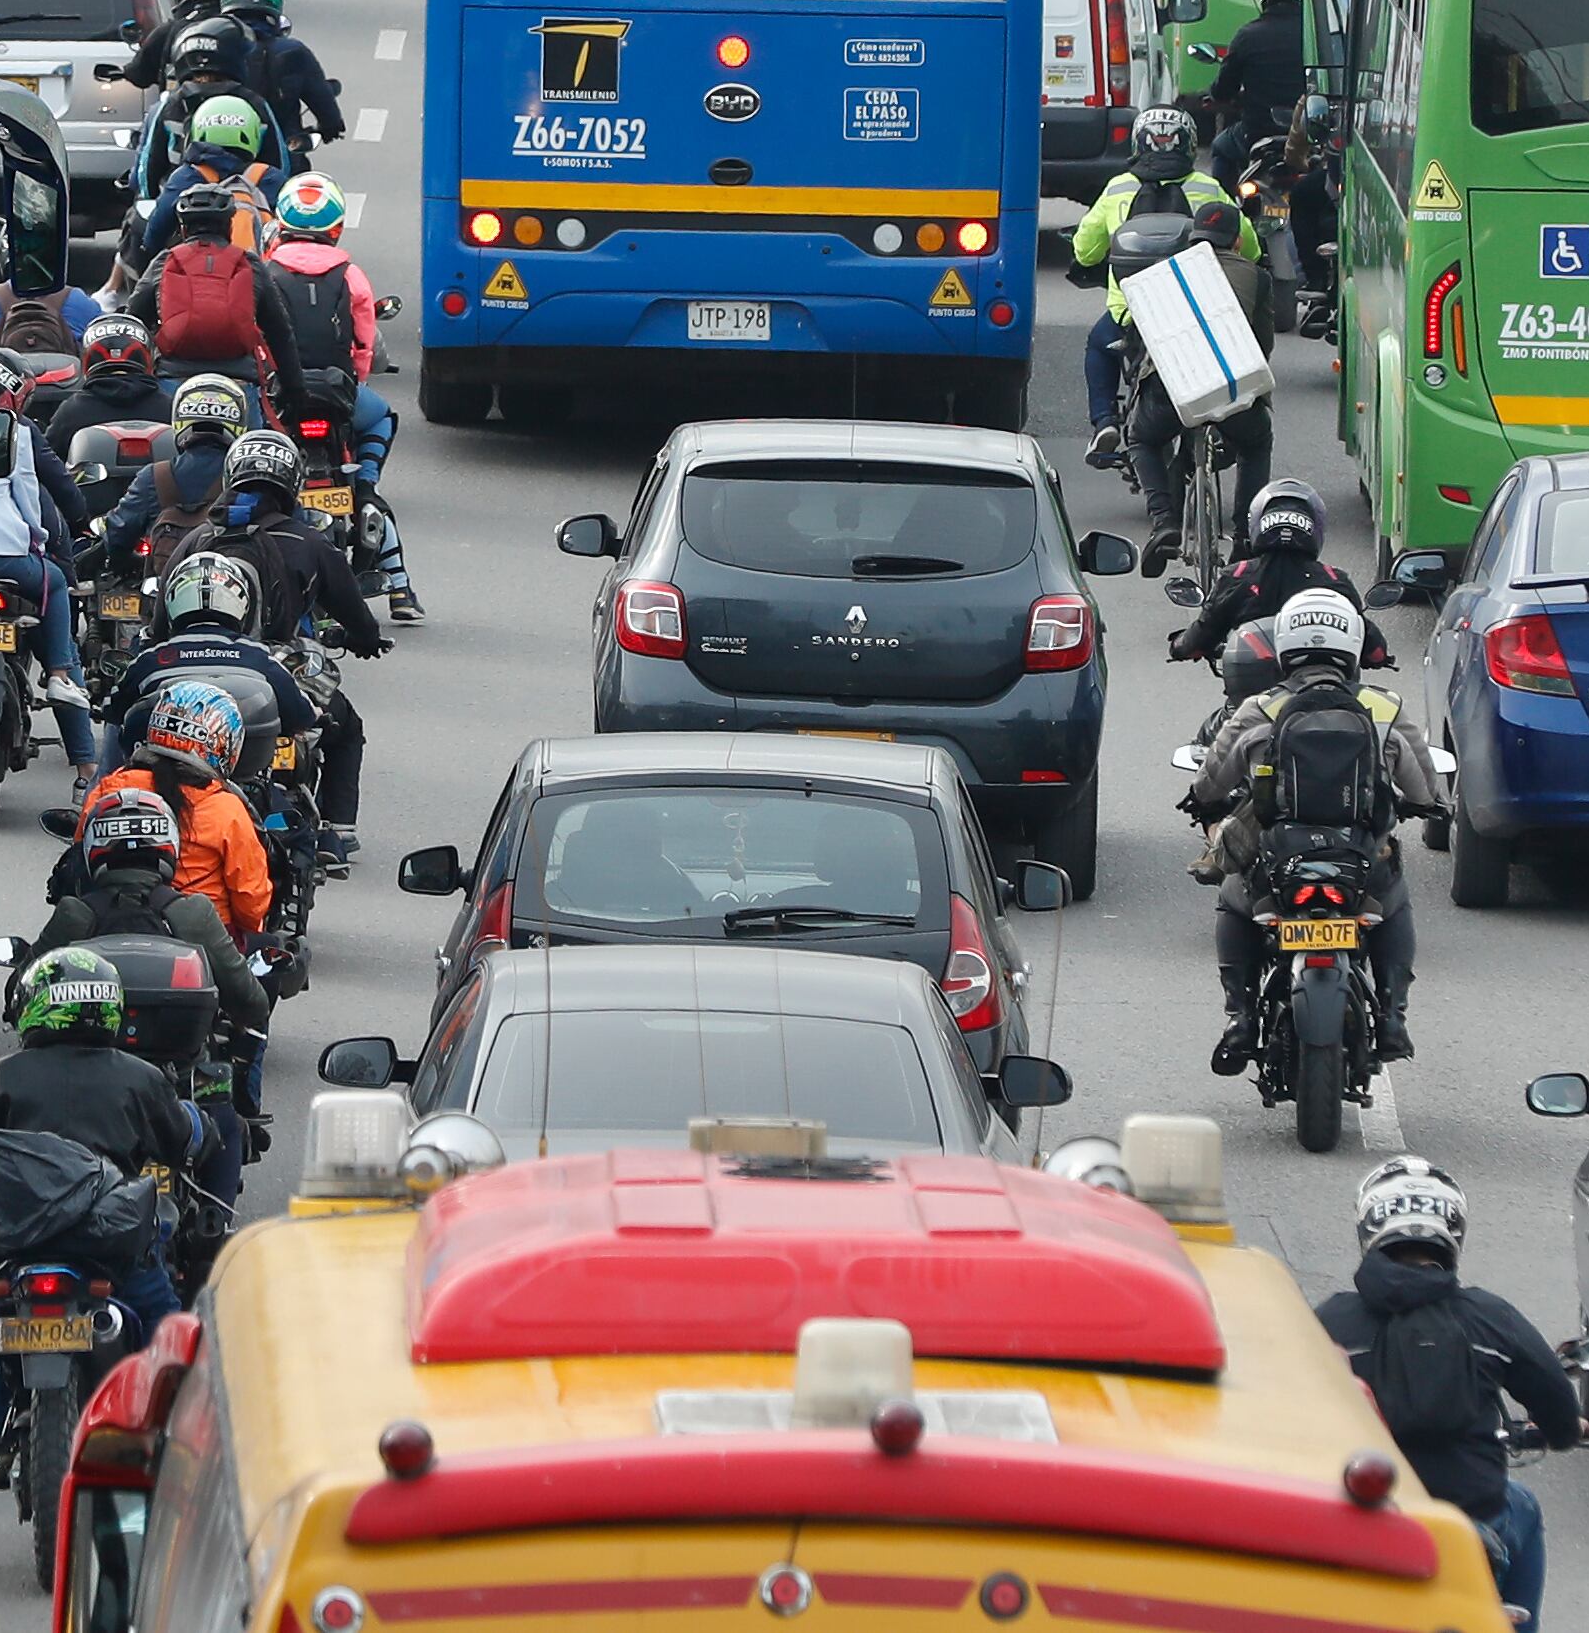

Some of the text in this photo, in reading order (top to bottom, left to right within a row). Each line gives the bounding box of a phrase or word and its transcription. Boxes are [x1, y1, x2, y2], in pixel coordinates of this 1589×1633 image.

[543, 89, 617, 101] TRANSMILENIO
[864, 91, 899, 105] CEDA
[710, 95, 755, 111] BYD
[855, 105, 908, 120] EL PASO
[512, 114, 646, 153] Z66-7052
[481, 298, 529, 310] PUNTO CIEGO
[927, 307, 952, 317] PUNTO
[1502, 346, 1529, 360] ZMO
[1530, 344, 1589, 361] FONTIBÓN
[810, 634, 901, 648] SANDERO
